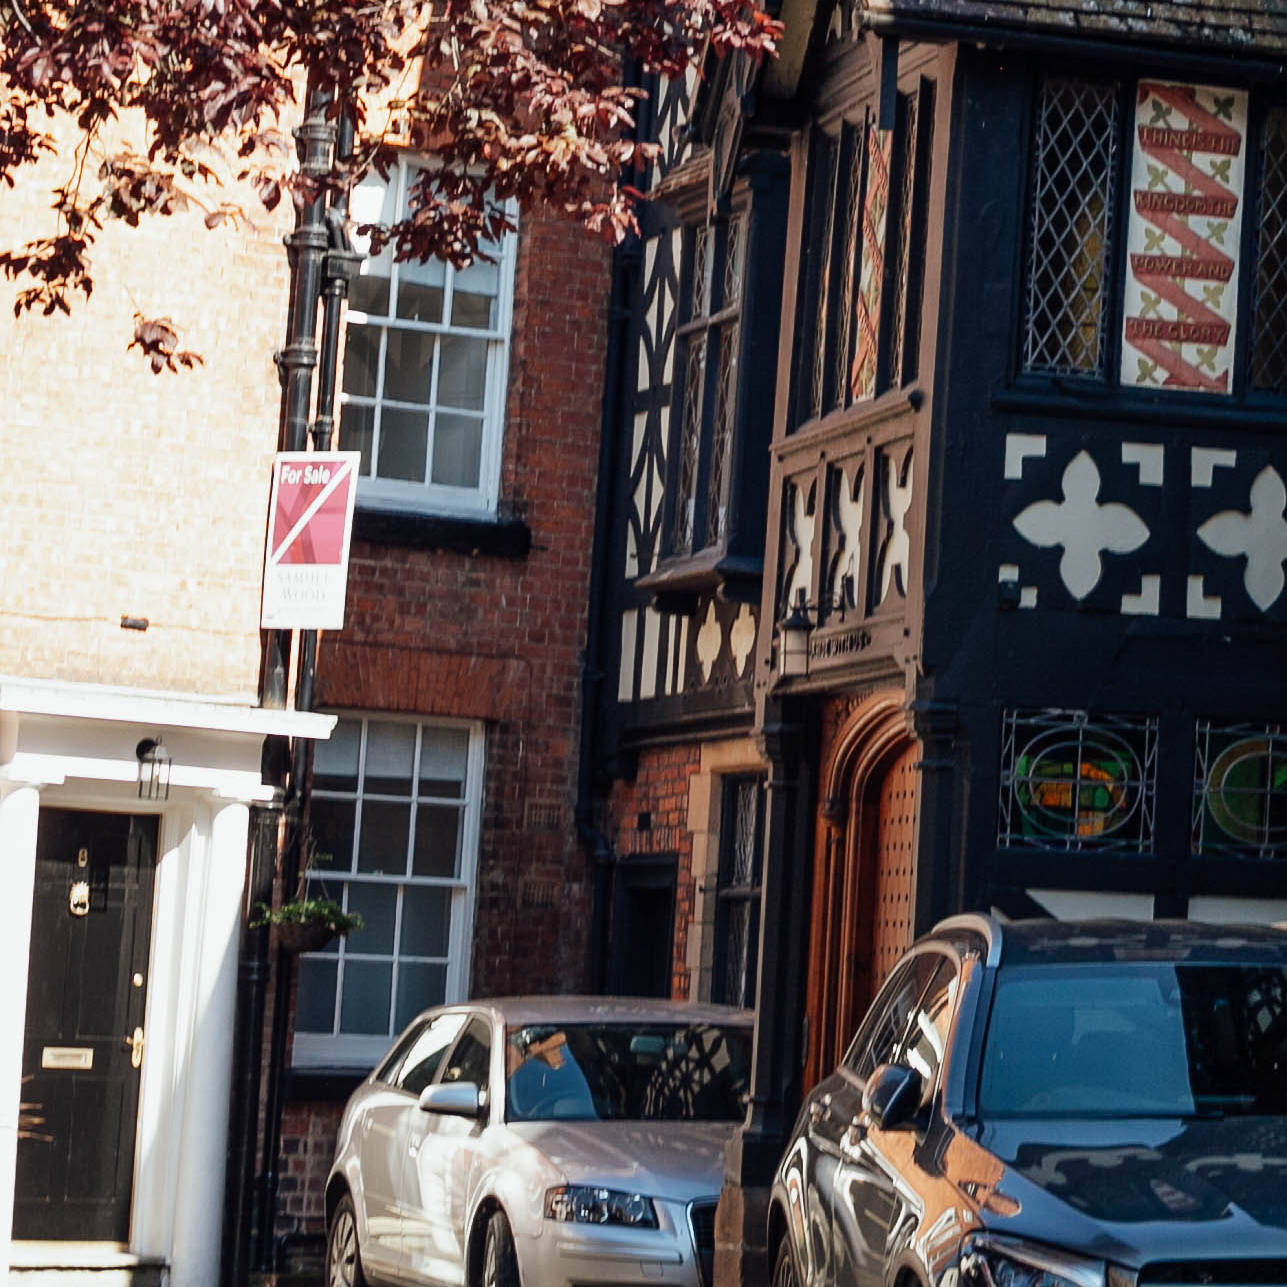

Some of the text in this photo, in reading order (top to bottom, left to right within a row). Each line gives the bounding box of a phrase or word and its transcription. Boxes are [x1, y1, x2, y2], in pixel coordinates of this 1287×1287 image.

[1134, 256, 1230, 280] POWER AND
[281, 465, 331, 485] For Sale
